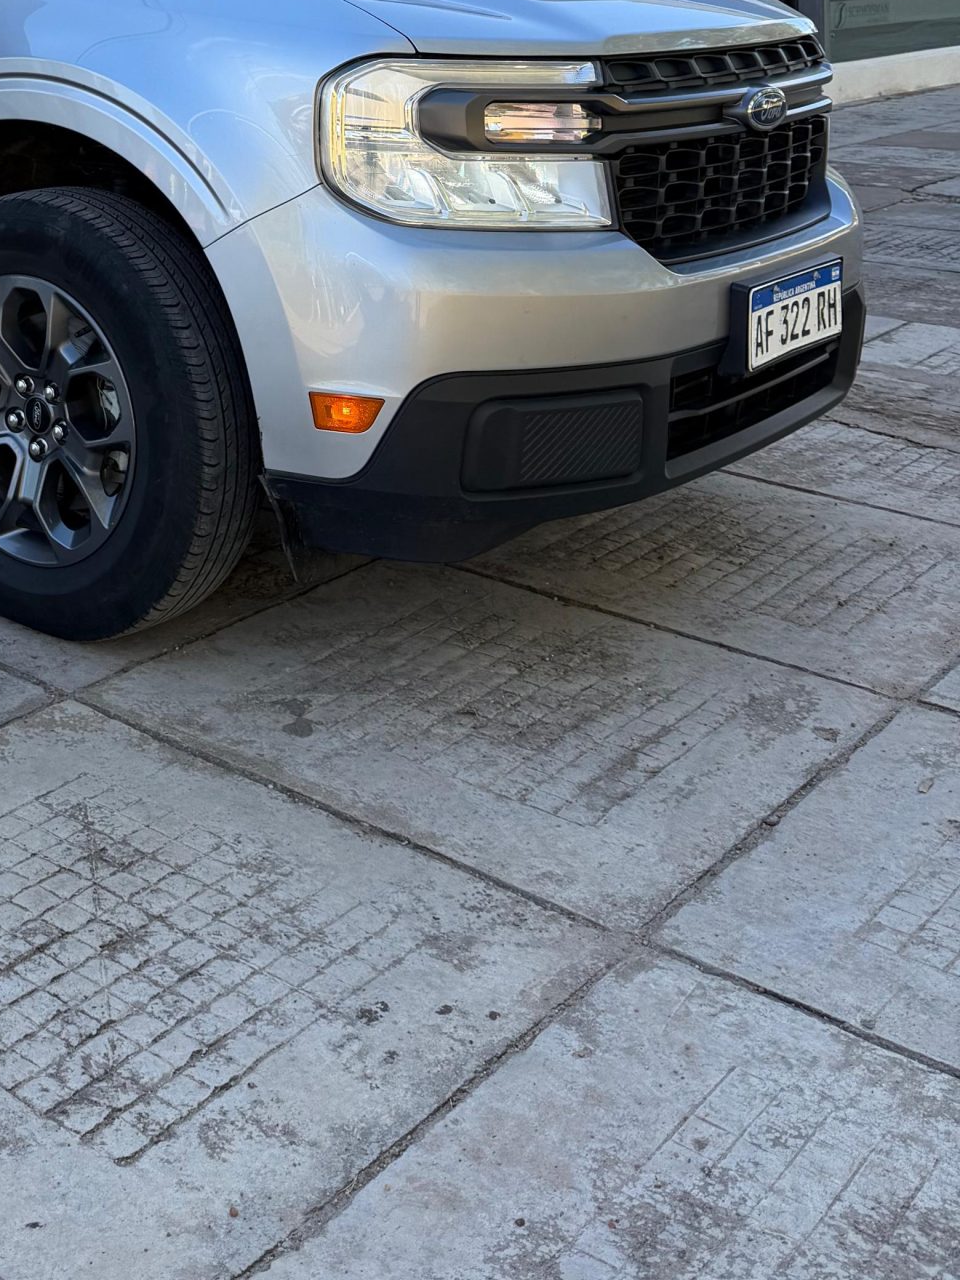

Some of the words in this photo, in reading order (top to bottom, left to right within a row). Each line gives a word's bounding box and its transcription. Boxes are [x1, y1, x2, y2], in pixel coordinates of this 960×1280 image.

[755, 309, 775, 358] AF
[780, 296, 811, 346] 322
[817, 287, 838, 332] RH
